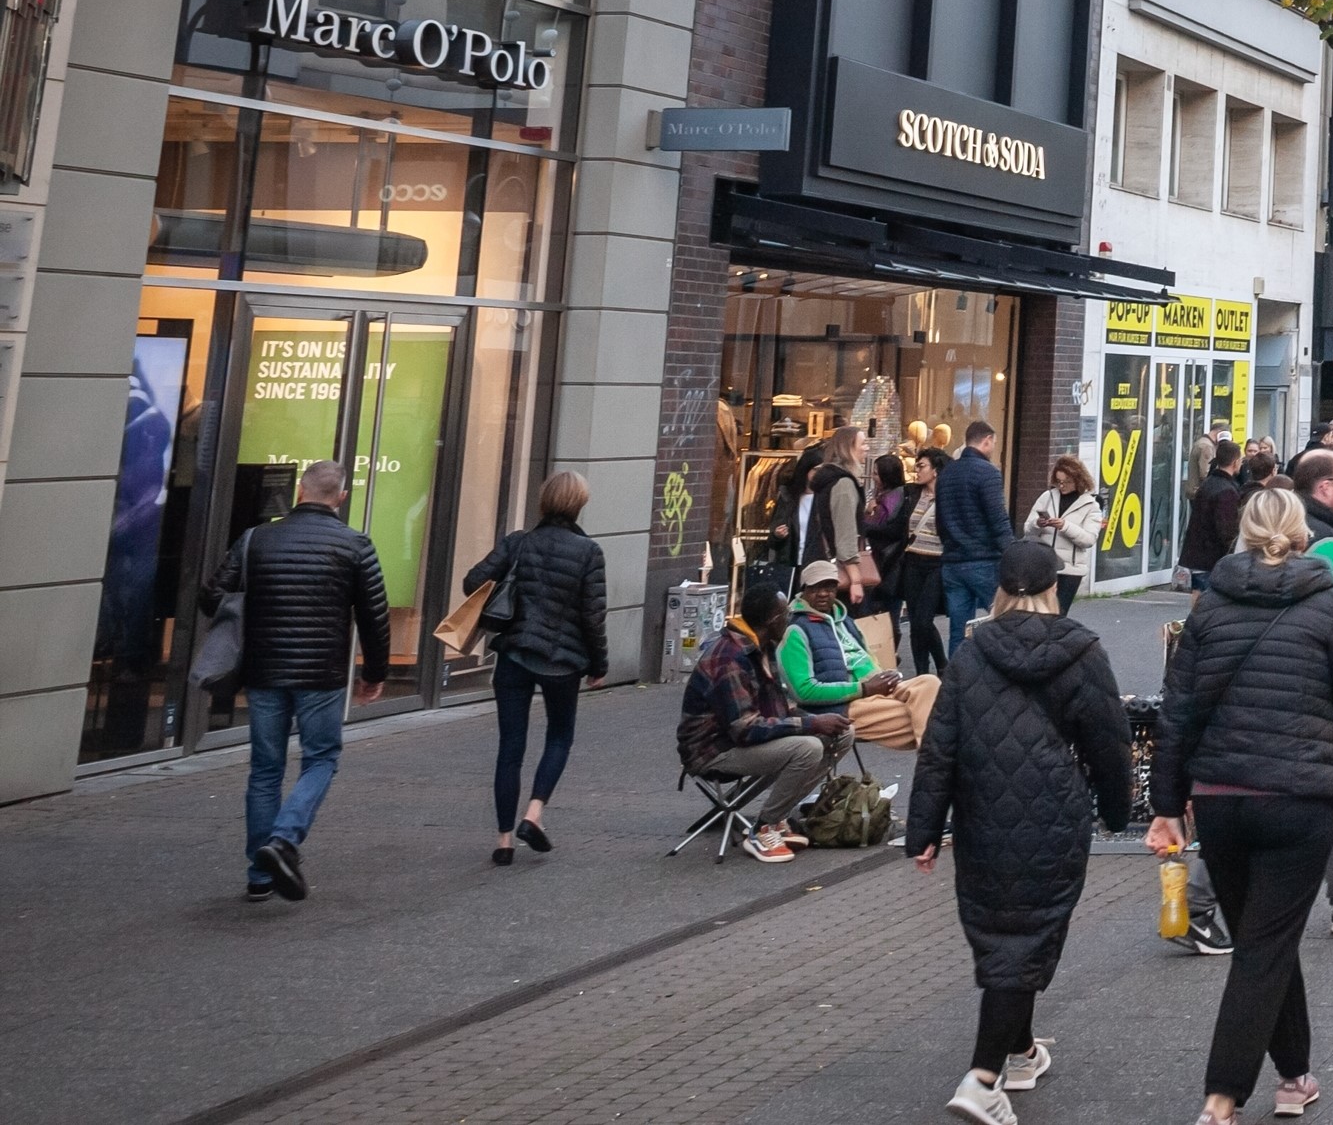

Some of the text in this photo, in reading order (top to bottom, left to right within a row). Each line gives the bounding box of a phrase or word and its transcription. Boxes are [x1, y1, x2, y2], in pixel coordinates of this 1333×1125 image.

[413, 19, 552, 92] O'Polo
[667, 122, 777, 136] Marc O'Polo
[1109, 302, 1151, 324] POP-UP
[1163, 305, 1205, 329] MARKEN
[1216, 309, 1249, 333] OUTLET
[261, 340, 346, 358] IT'S ON US
[254, 382, 341, 401] SINCE 196
